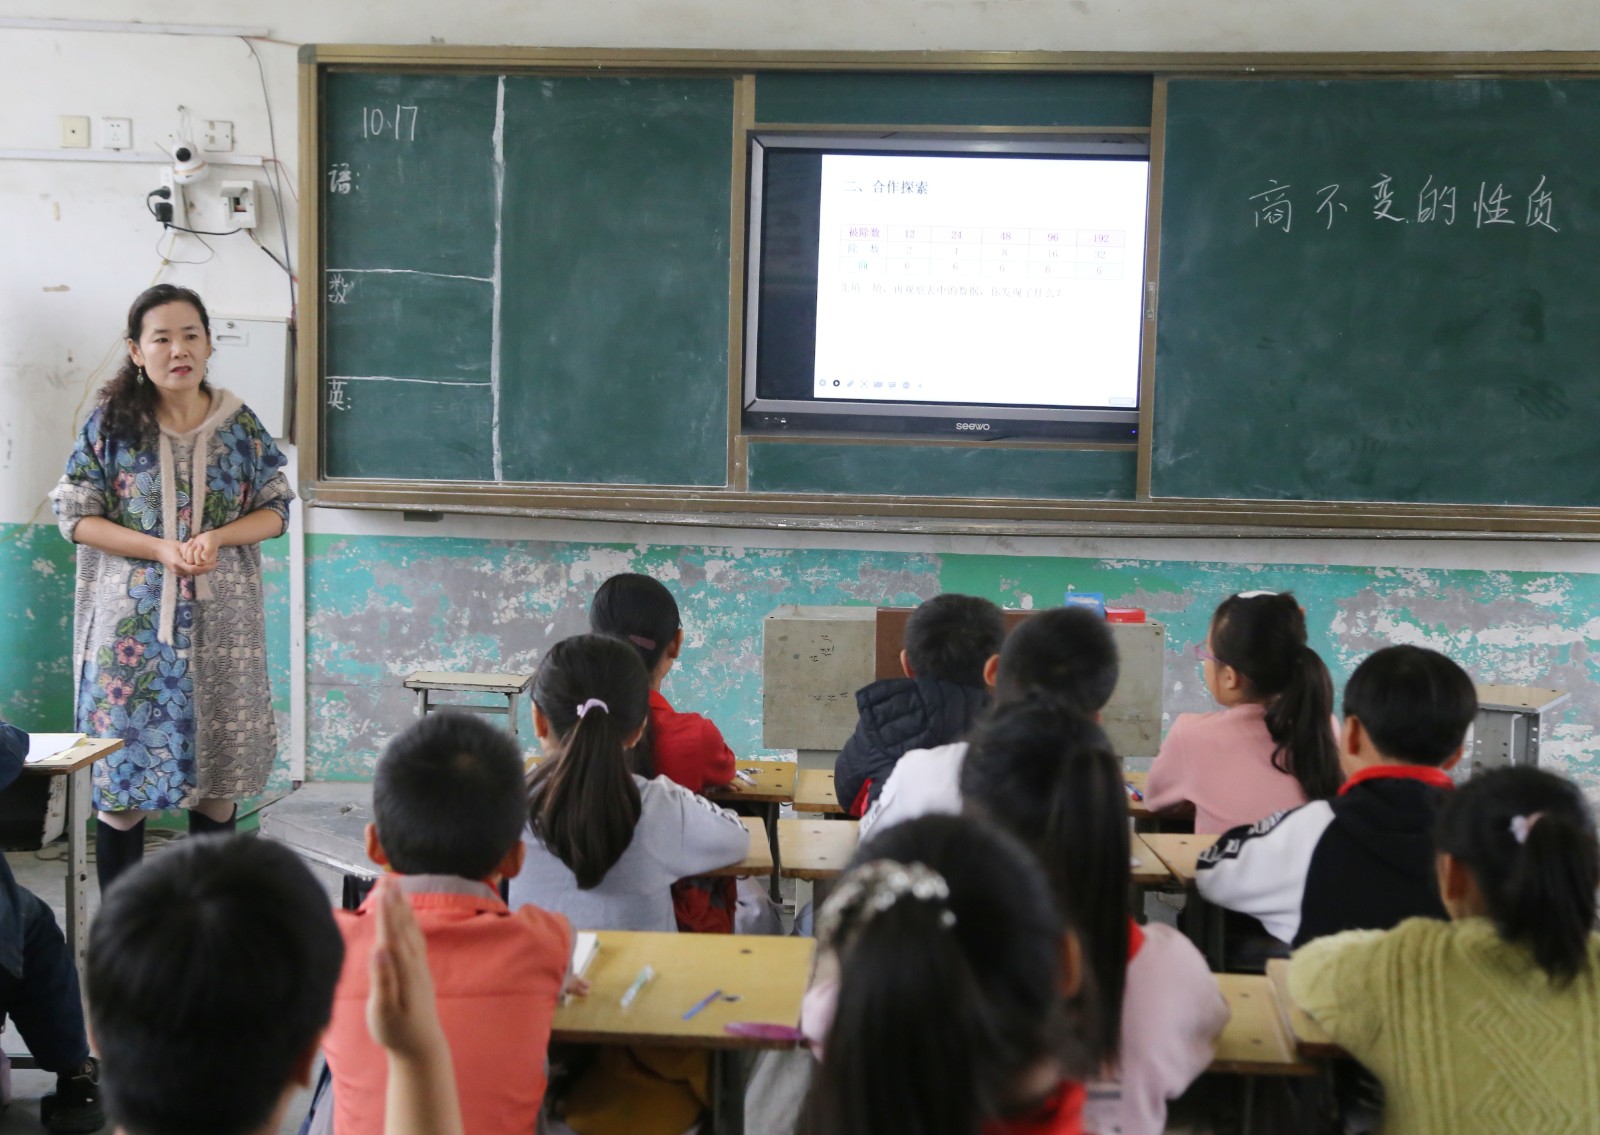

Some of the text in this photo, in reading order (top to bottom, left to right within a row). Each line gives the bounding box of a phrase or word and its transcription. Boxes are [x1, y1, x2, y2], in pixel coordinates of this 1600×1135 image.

[843, 179, 929, 195] 二、合作探索
[1248, 172, 1561, 233] 商不变的性质
[904, 229, 916, 239] 12
[951, 230, 963, 240] 24
[999, 232, 1012, 241] 48
[1047, 233, 1059, 242] 96
[1093, 234, 1110, 243] 192
[955, 421, 990, 431] seewo
